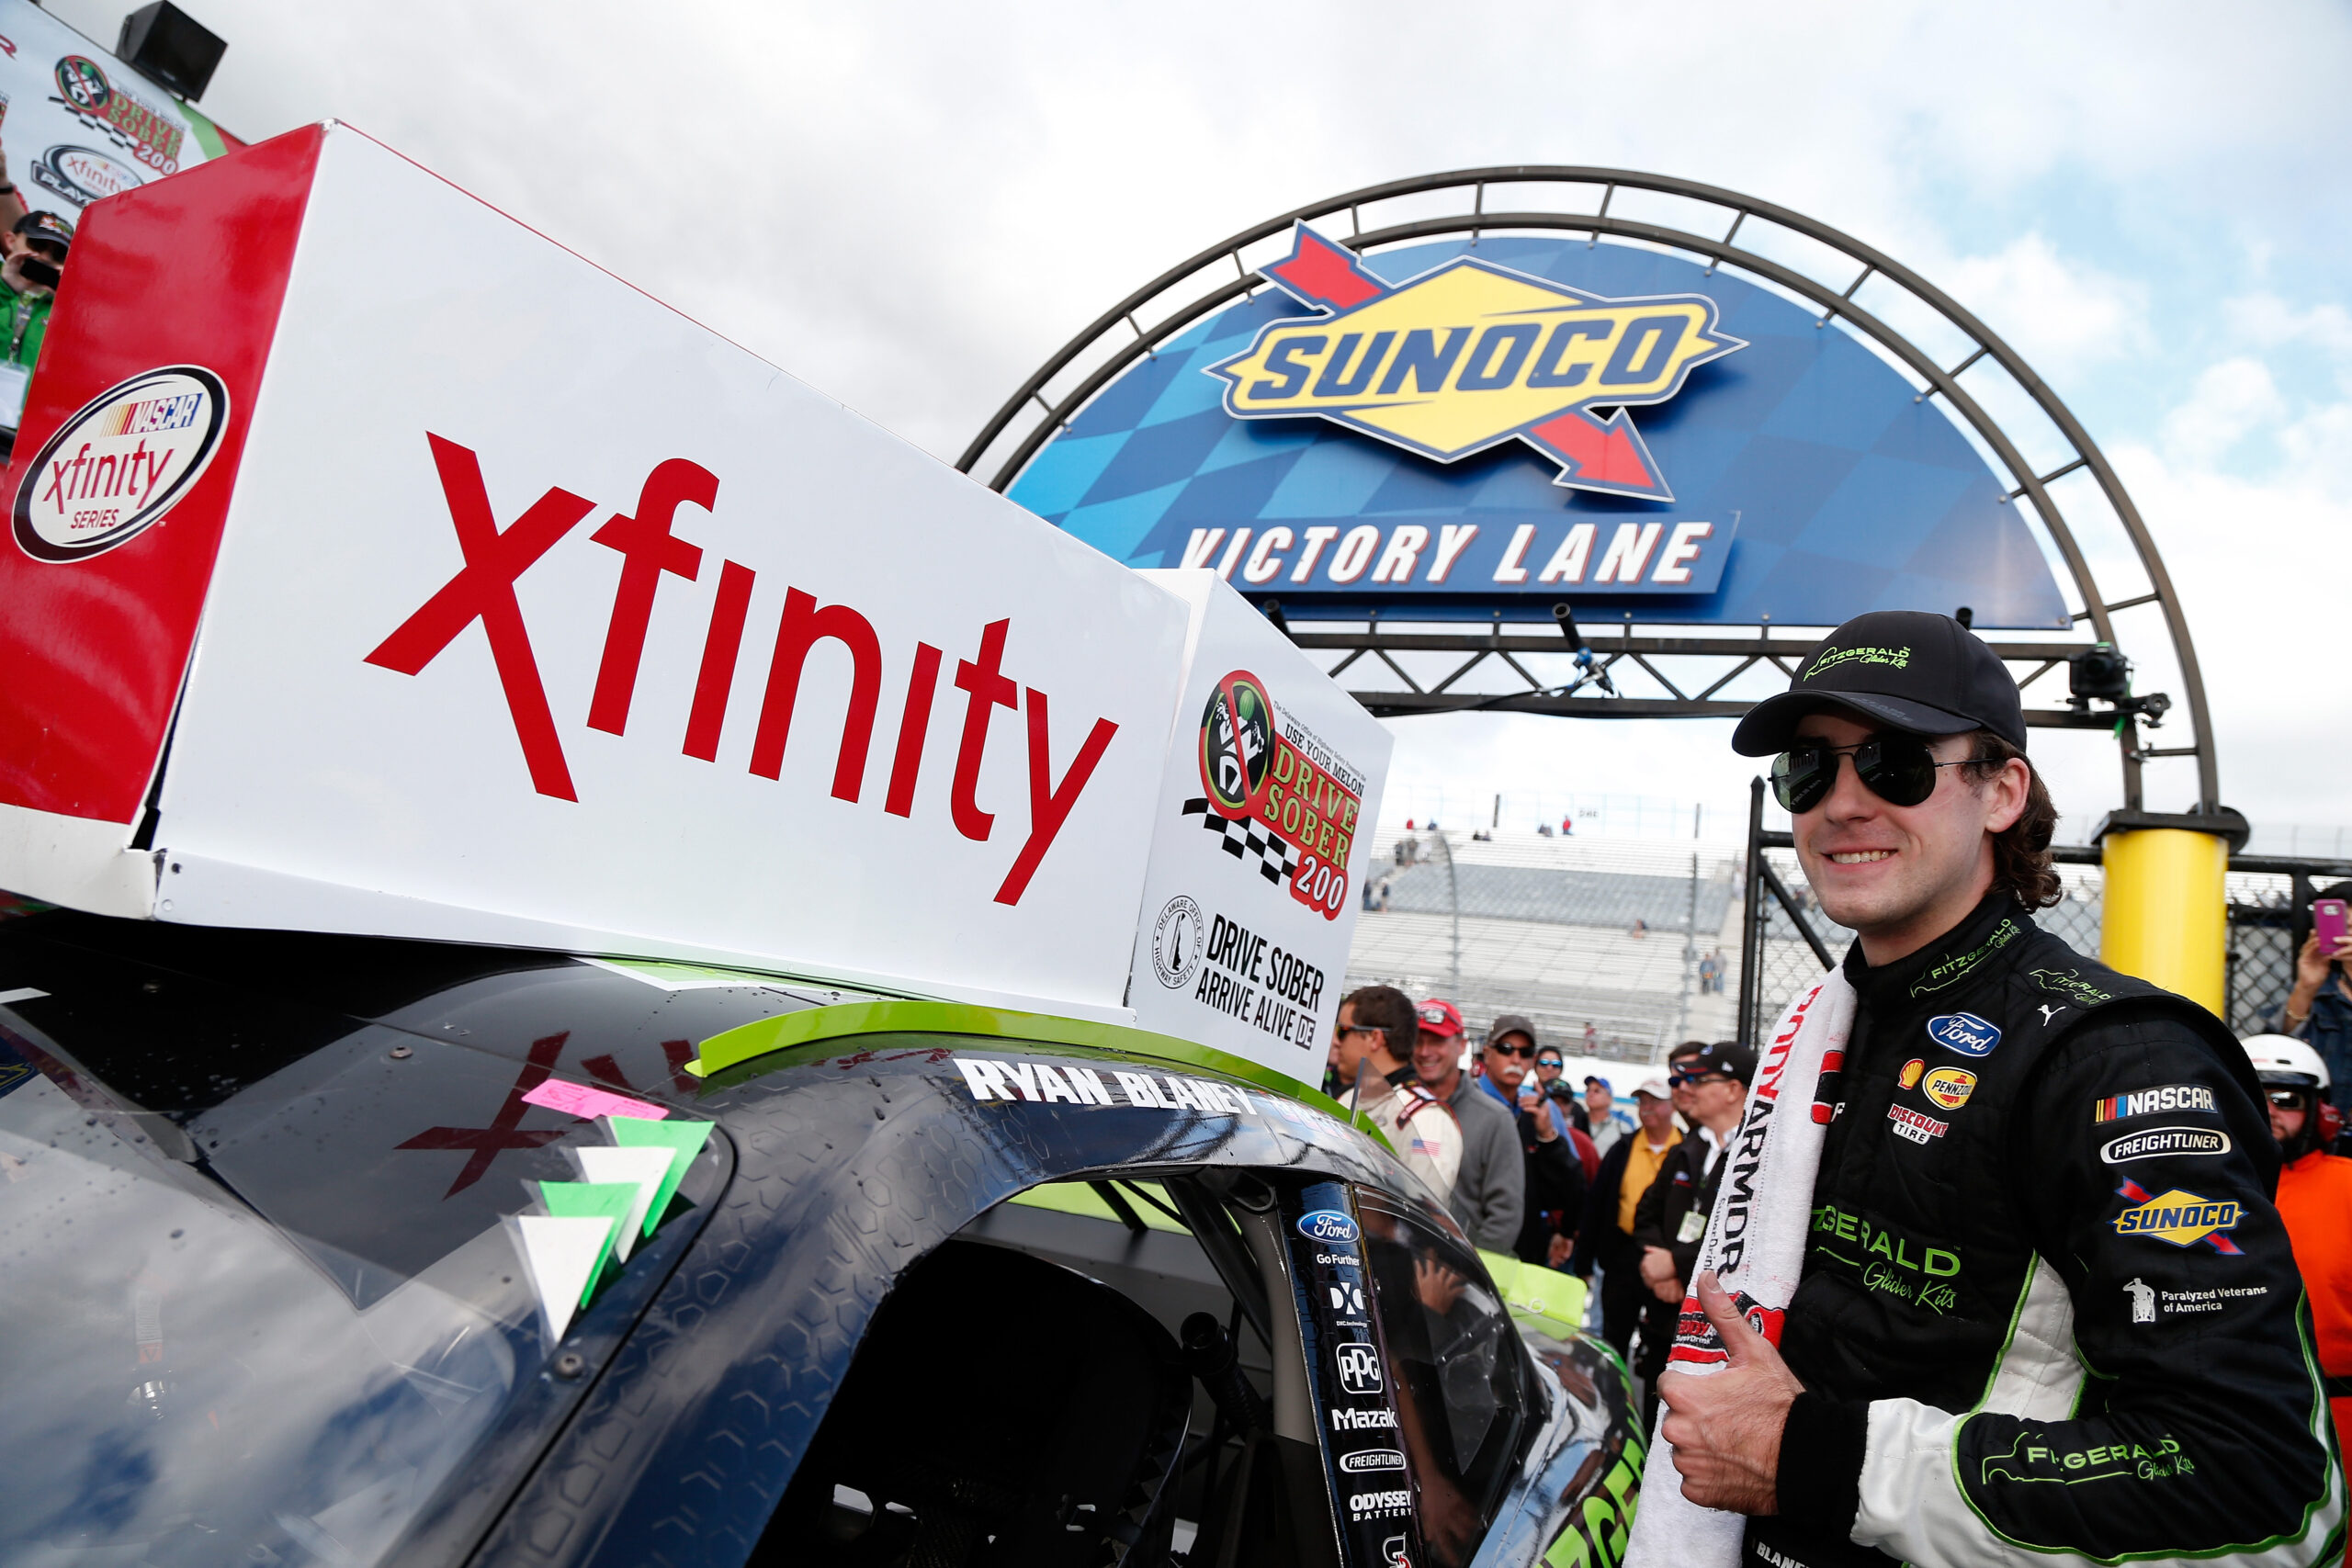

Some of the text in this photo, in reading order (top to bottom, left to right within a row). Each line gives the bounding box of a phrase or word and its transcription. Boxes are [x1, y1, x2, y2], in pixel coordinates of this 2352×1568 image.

[107, 107, 179, 159] SOBER
[111, 93, 183, 142] DRIVE
[138, 143, 176, 174] 200
[1247, 314, 1691, 400] SUNOCO
[128, 393, 201, 434] NASCAR
[43, 437, 175, 515] xfinity
[70, 508, 119, 529] SERIES
[1178, 521, 1714, 585] VICTORY LANE
[361, 430, 1120, 907] xfinity
[1819, 647, 1910, 666] FITZGERALD
[1285, 723, 1365, 797] USE YOUR MELON
[1272, 742, 1361, 838] DRIVE
[1263, 783, 1351, 871] SOBER
[1295, 855, 1345, 911] 200
[1158, 899, 1188, 931] DELAWARE
[1188, 904, 1202, 931] OFFICE
[1206, 913, 1325, 1013] DRIVE SOBER
[1930, 919, 2011, 979] FITZGEALD
[1154, 947, 1194, 986] HIGHWAY SAFETY
[1194, 966, 1315, 1049] ARRIVE ALIVE DE
[1938, 1012, 1995, 1053] Ford
[953, 1058, 1258, 1115] RYAN BLANEY
[1931, 1078, 1973, 1097] PENNZOIL
[2126, 1086, 2215, 1117] NASCAR
[1888, 1104, 1950, 1138] DISCOUNT
[1896, 1123, 1928, 1143] TIRE
[2114, 1133, 2220, 1158] FREIGHTLINER
[1314, 1213, 1352, 1240] Ford
[2120, 1204, 2237, 1232] SUNOCO
[1316, 1253, 1360, 1267] Go Further
[1863, 1261, 1958, 1315] Glider Kits
[2161, 1286, 2268, 1303] Paralyzed Veterans
[2164, 1301, 2223, 1314] of America
[1340, 1348, 1380, 1388] PPG
[1331, 1406, 1399, 1431] Mazak
[1348, 1454, 1403, 1469] FREIGHTLINER
[2027, 1438, 2180, 1470] FIGERALD
[1349, 1490, 1411, 1512] ODYSSEY
[1352, 1507, 1412, 1522] BATTERY
[1756, 1541, 1810, 1568] BLAN
